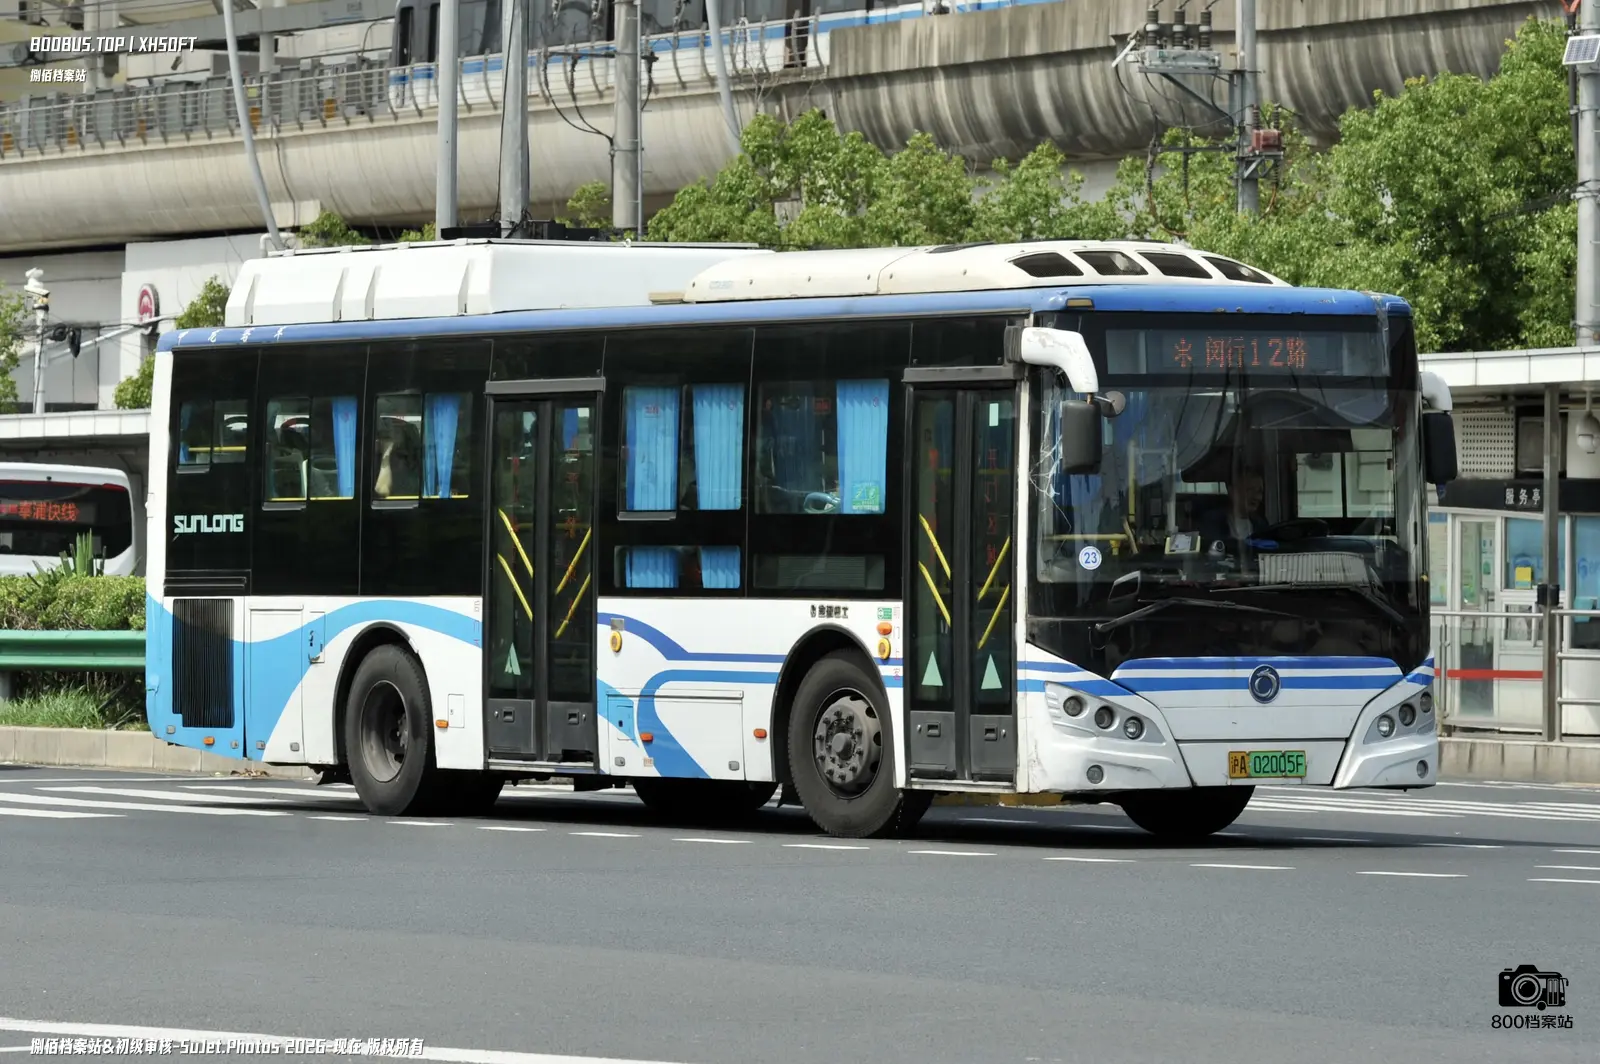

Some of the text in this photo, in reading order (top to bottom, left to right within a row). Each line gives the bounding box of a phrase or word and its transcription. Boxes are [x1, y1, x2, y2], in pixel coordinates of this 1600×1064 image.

[1505, 487, 1541, 505] 服务亭
[174, 514, 244, 533] SUNLONG
[1084, 551, 1098, 564] 23
[1253, 754, 1304, 774] 02005F
